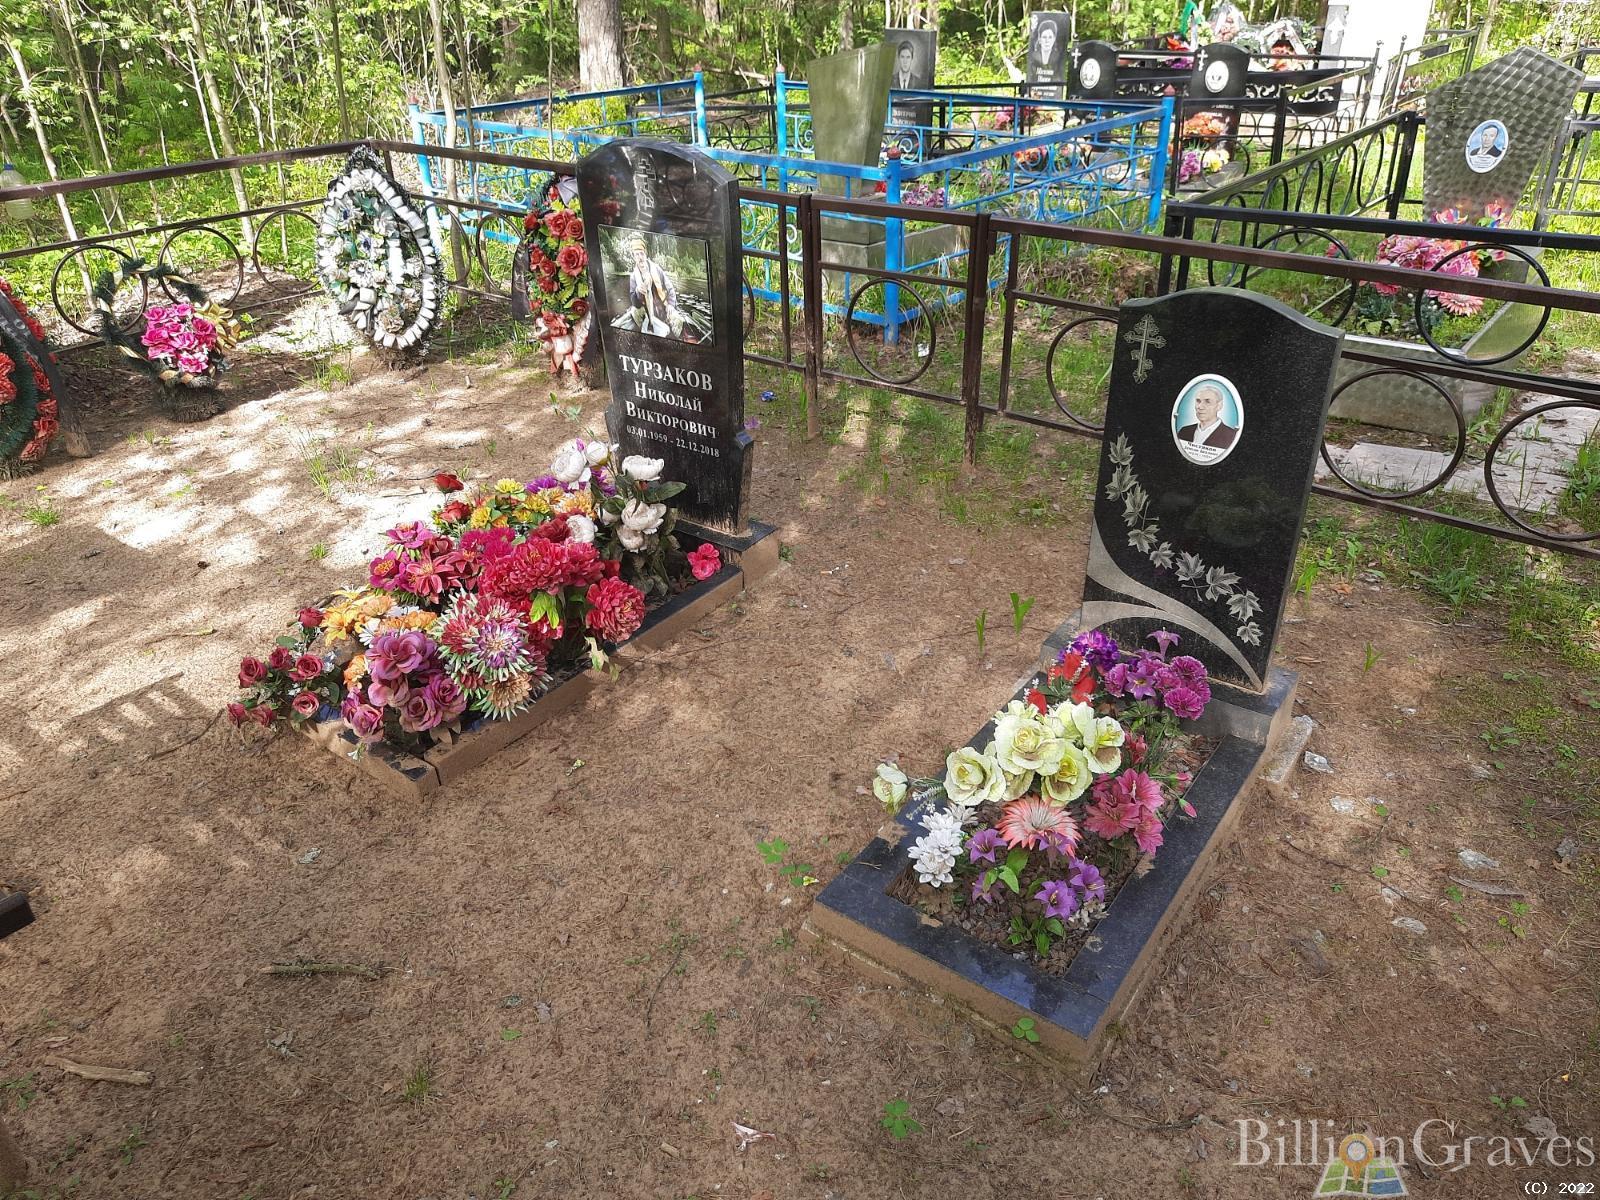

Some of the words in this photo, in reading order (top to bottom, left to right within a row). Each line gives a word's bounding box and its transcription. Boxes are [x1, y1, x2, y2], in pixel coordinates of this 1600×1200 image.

[618, 354, 713, 391] ТУРЗАКОВ
[626, 424, 668, 443] 03.01.1959
[676, 438, 720, 458] 22.12.2018
